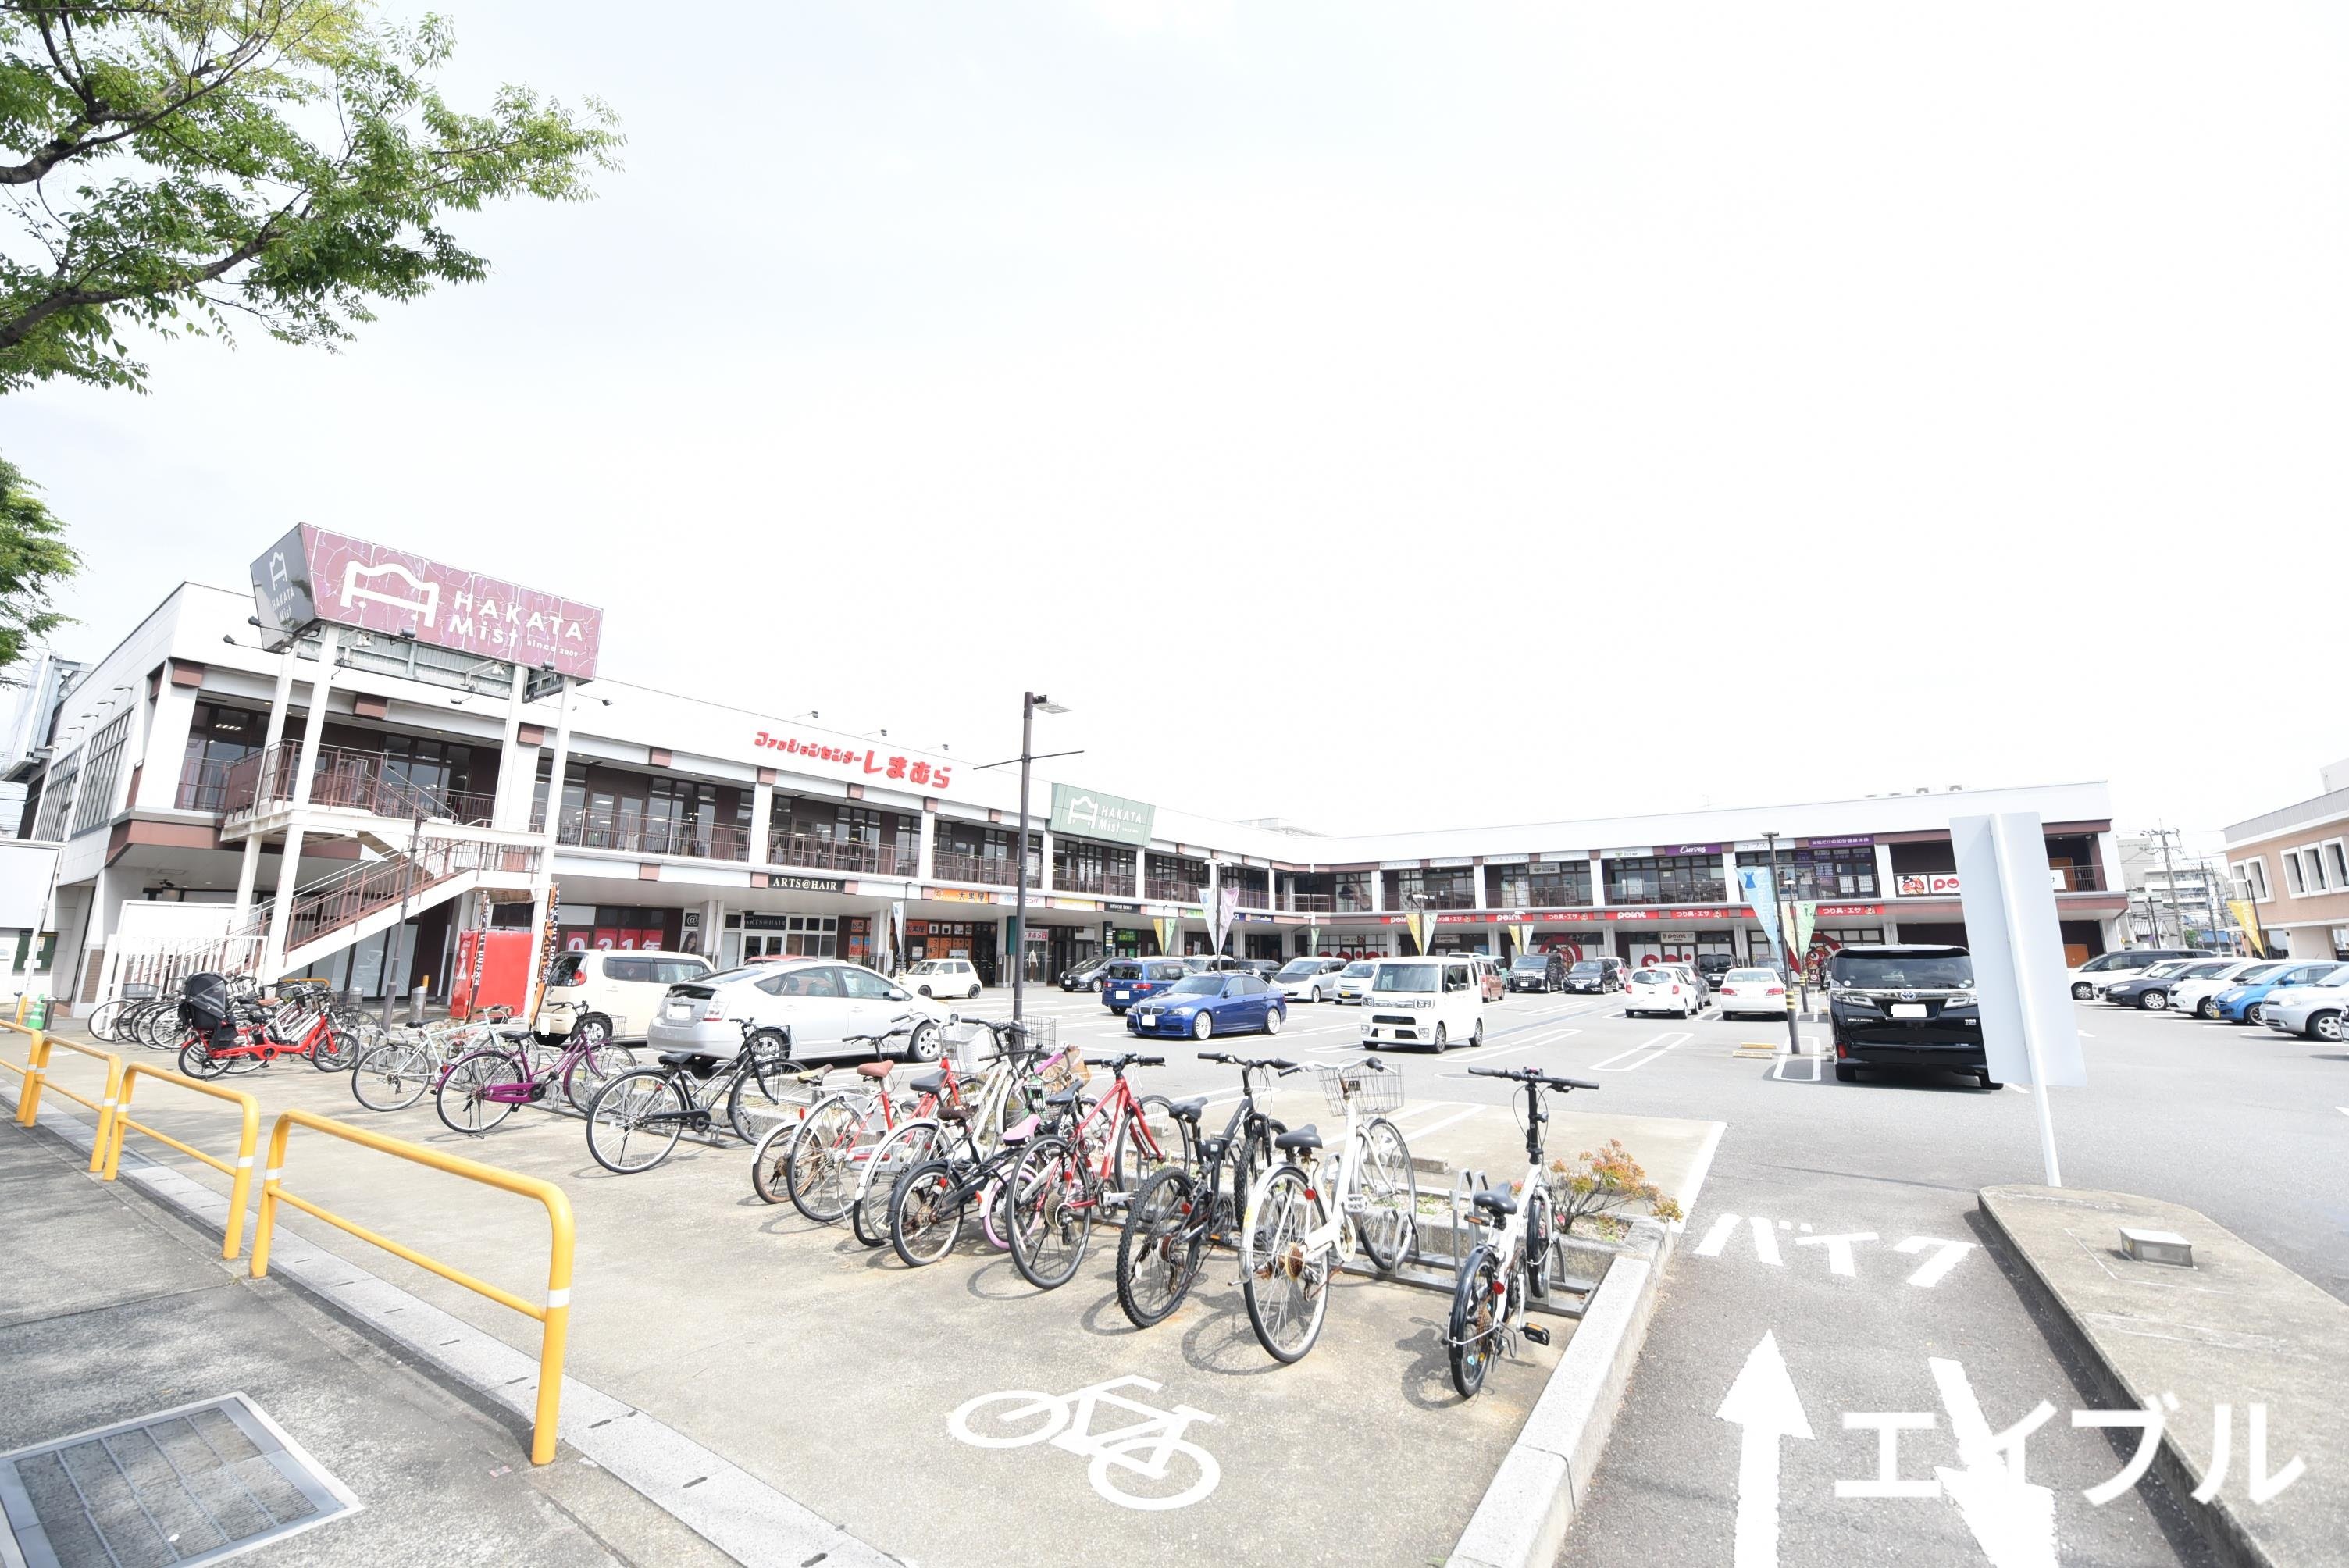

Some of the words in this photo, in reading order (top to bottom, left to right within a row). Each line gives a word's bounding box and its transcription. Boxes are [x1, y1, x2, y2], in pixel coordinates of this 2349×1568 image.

[272, 586, 295, 608] HAKATA
[279, 604, 292, 621] Mist
[454, 590, 583, 641] HAKATA
[448, 614, 518, 647] Mist
[526, 640, 556, 652] since
[559, 648, 579, 657] 2009
[754, 731, 862, 764] ファッションセンター
[864, 750, 952, 789] しまむら
[1101, 805, 1142, 824] HAKATA
[1098, 819, 1120, 833] Mist
[1680, 845, 1706, 854] Curves
[772, 877, 837, 891] ARTS@HAIR
[958, 892, 985, 902] 大黒屋
[1617, 911, 1647, 920] point
[1692, 1213, 1977, 1288] バイク
